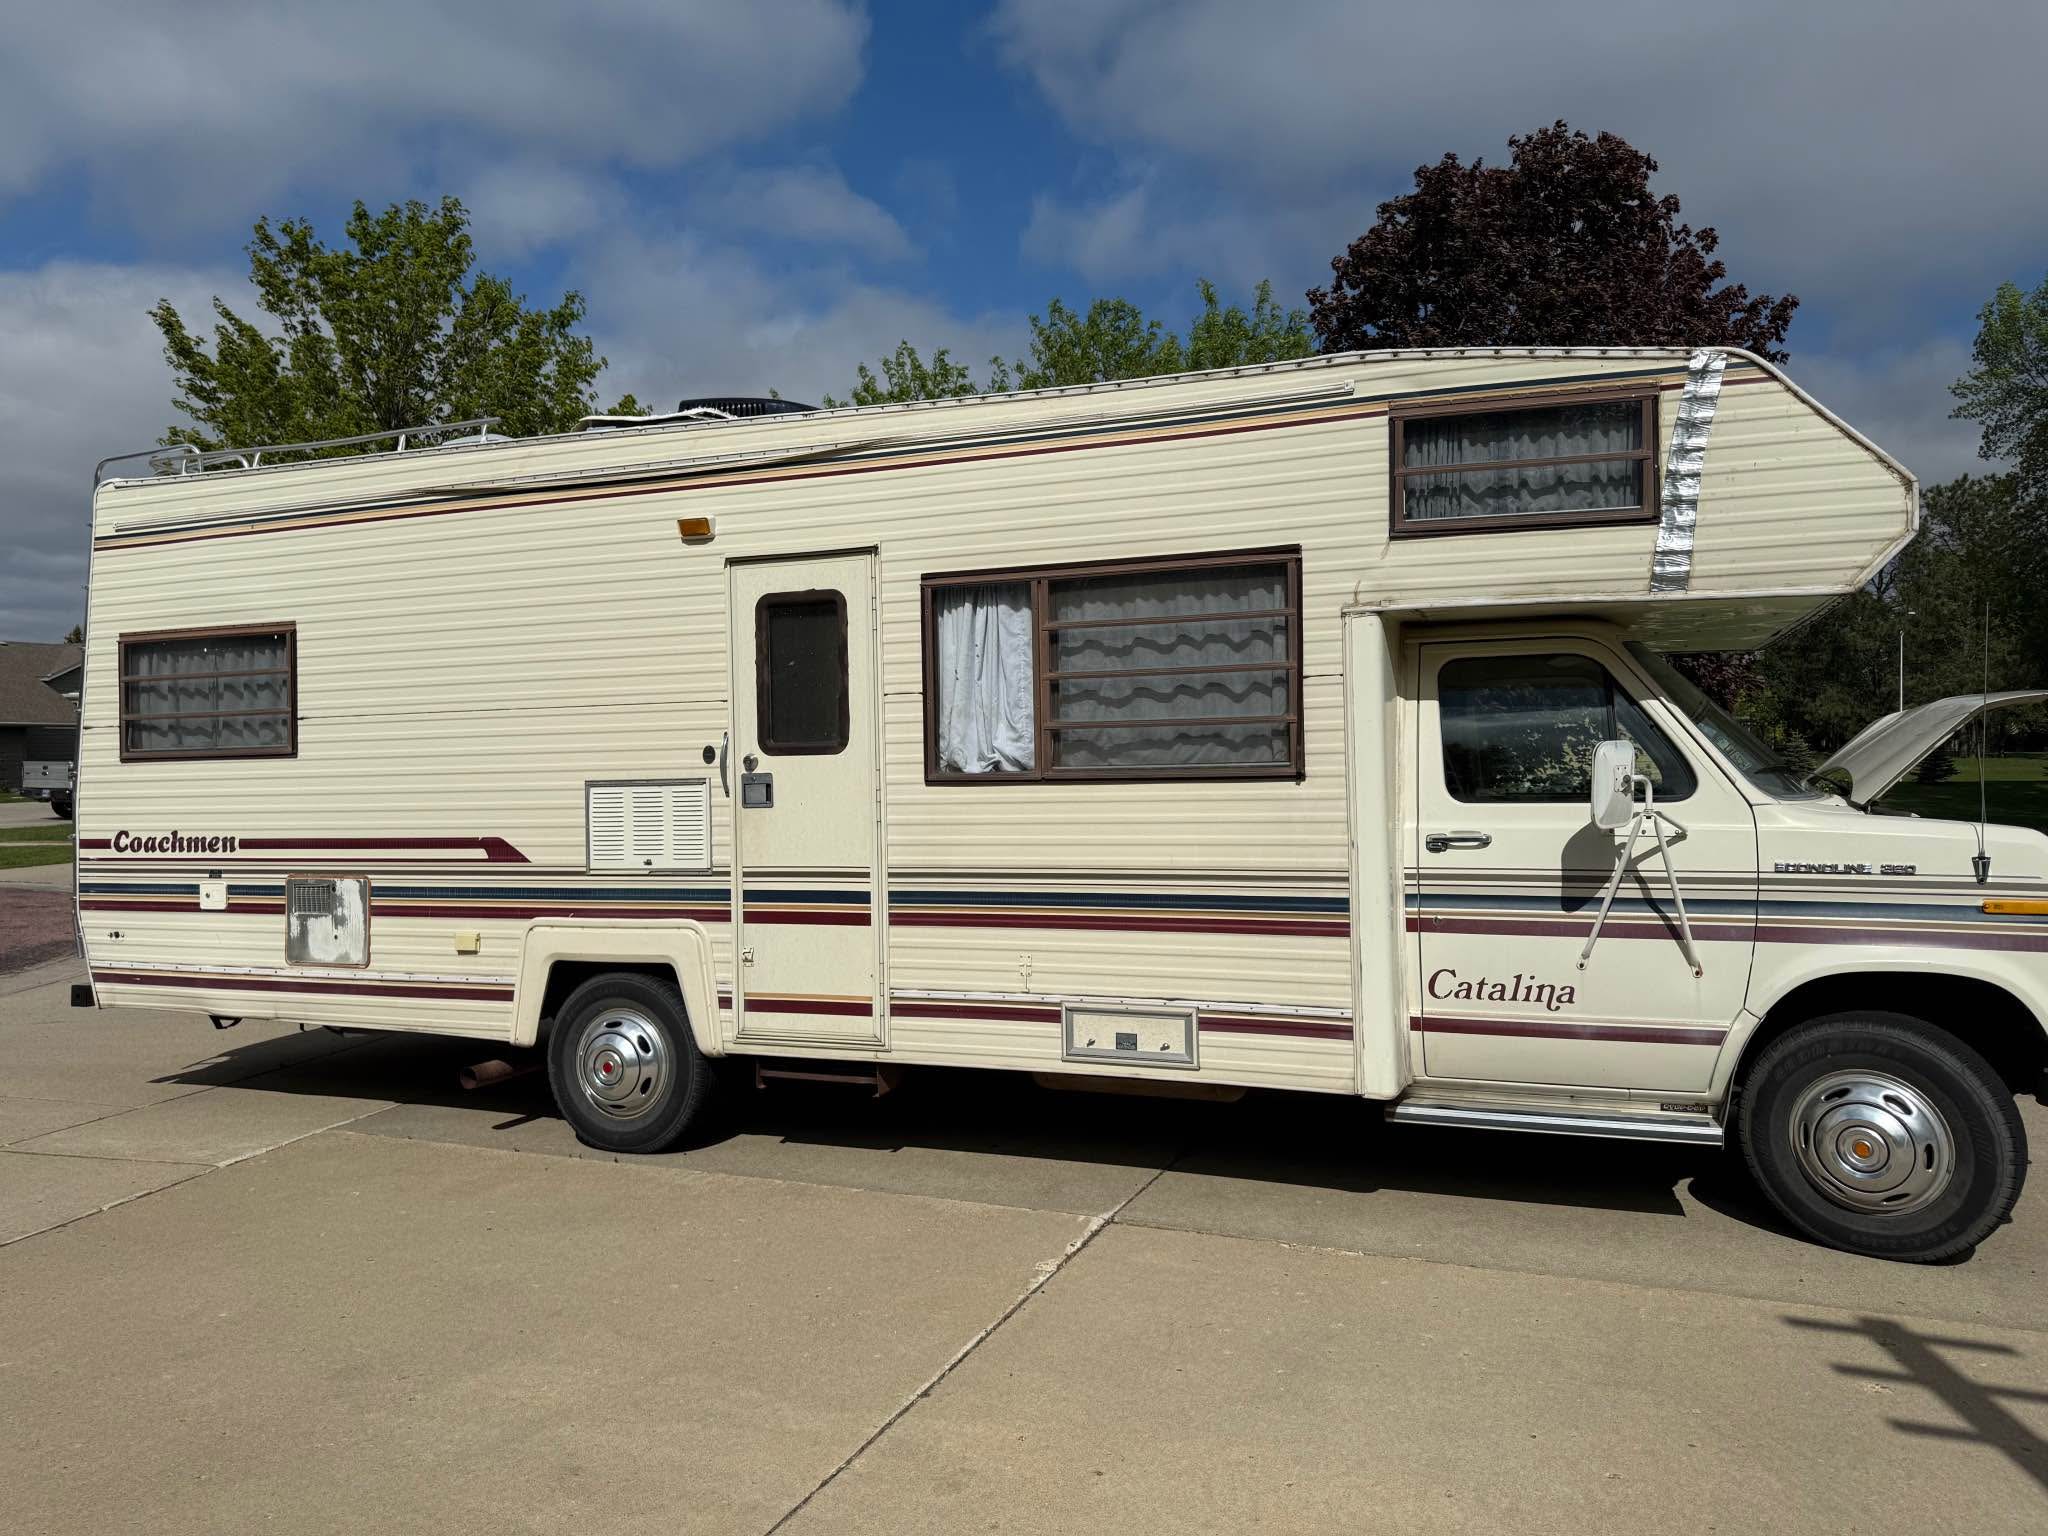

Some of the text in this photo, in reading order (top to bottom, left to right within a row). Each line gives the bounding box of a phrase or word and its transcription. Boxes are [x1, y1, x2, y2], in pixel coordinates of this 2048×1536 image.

[113, 830, 236, 854] Coachmen
[1774, 862, 1873, 875] ECONOLINE
[1428, 968, 1576, 1011] Catalina
